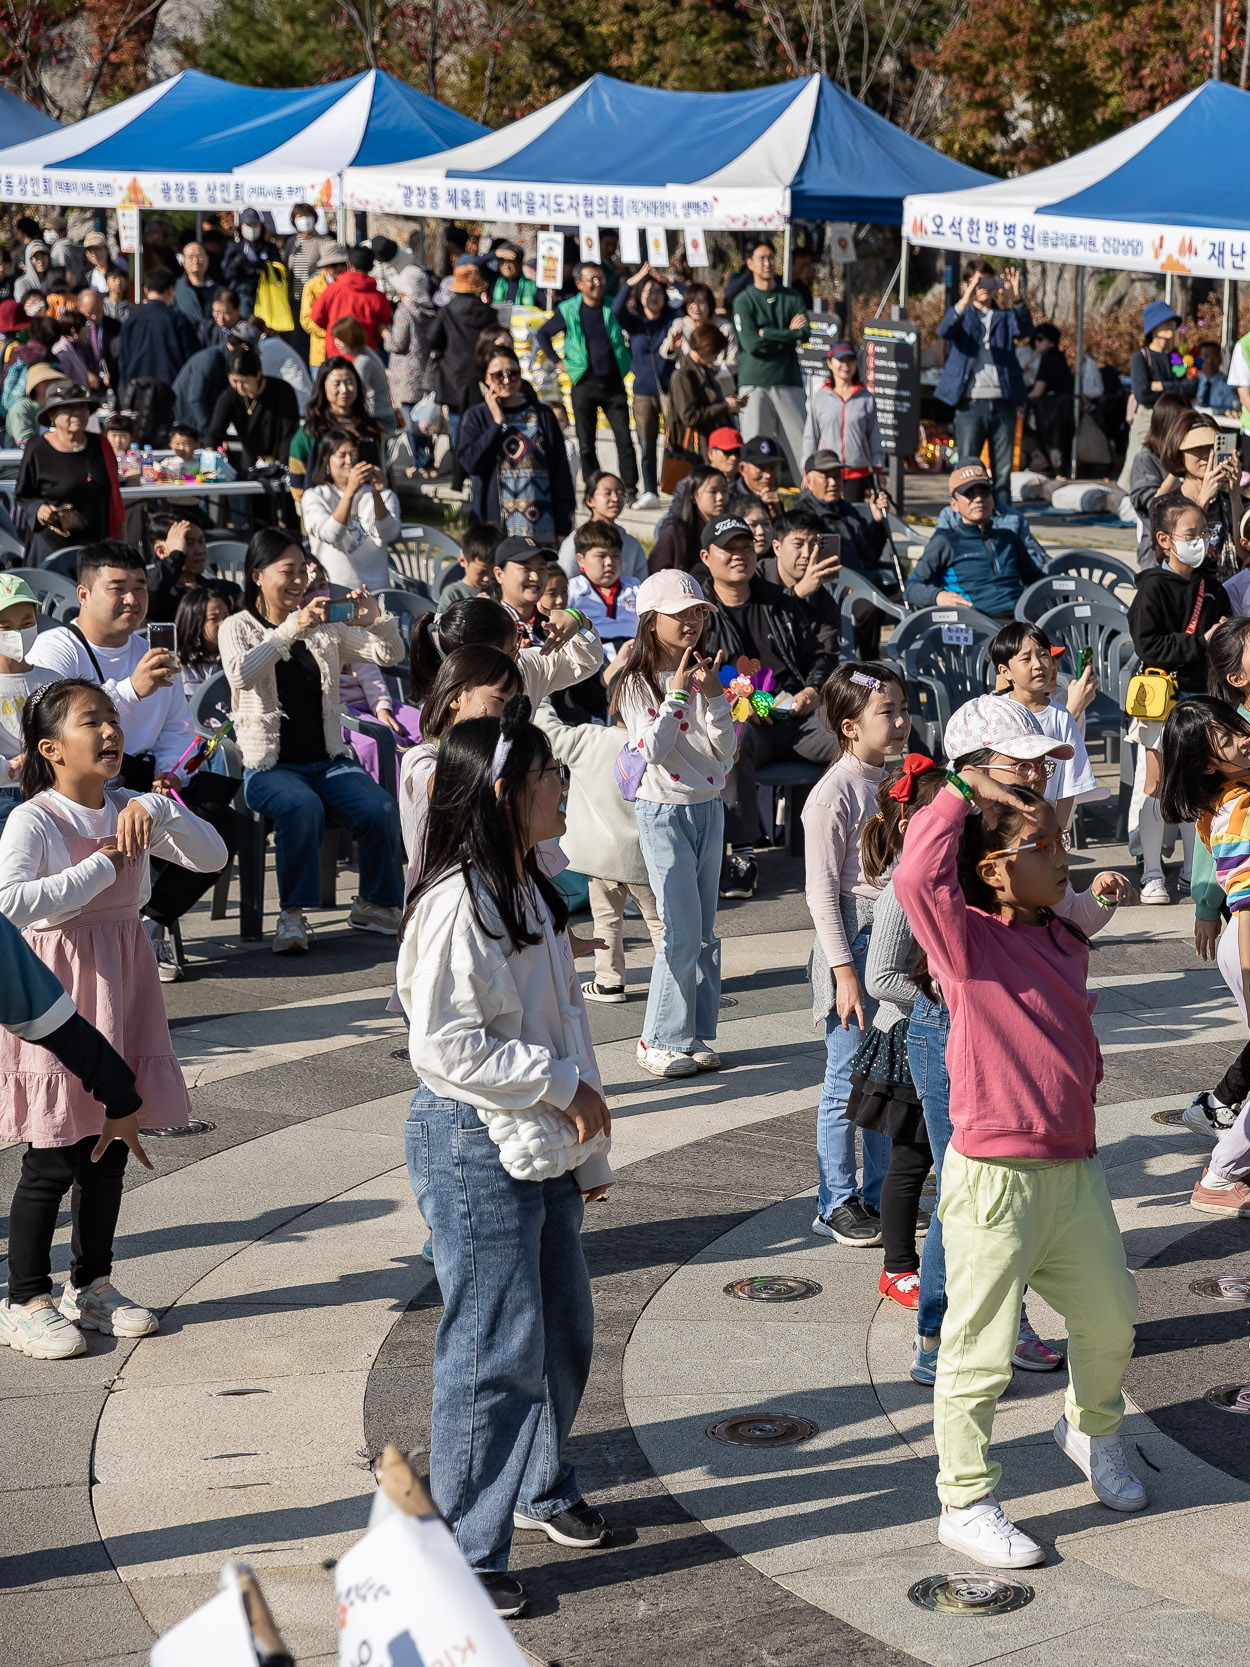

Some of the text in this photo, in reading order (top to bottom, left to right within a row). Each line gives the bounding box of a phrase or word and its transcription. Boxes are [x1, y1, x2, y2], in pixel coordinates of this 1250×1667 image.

[161, 181, 199, 204] 광장동
[206, 181, 246, 204] 상인회
[403, 184, 440, 210] 광장동
[447, 187, 486, 213] 체육회
[497, 191, 625, 220] 새마을지도자협의회
[931, 214, 1036, 251] 오석한방병원
